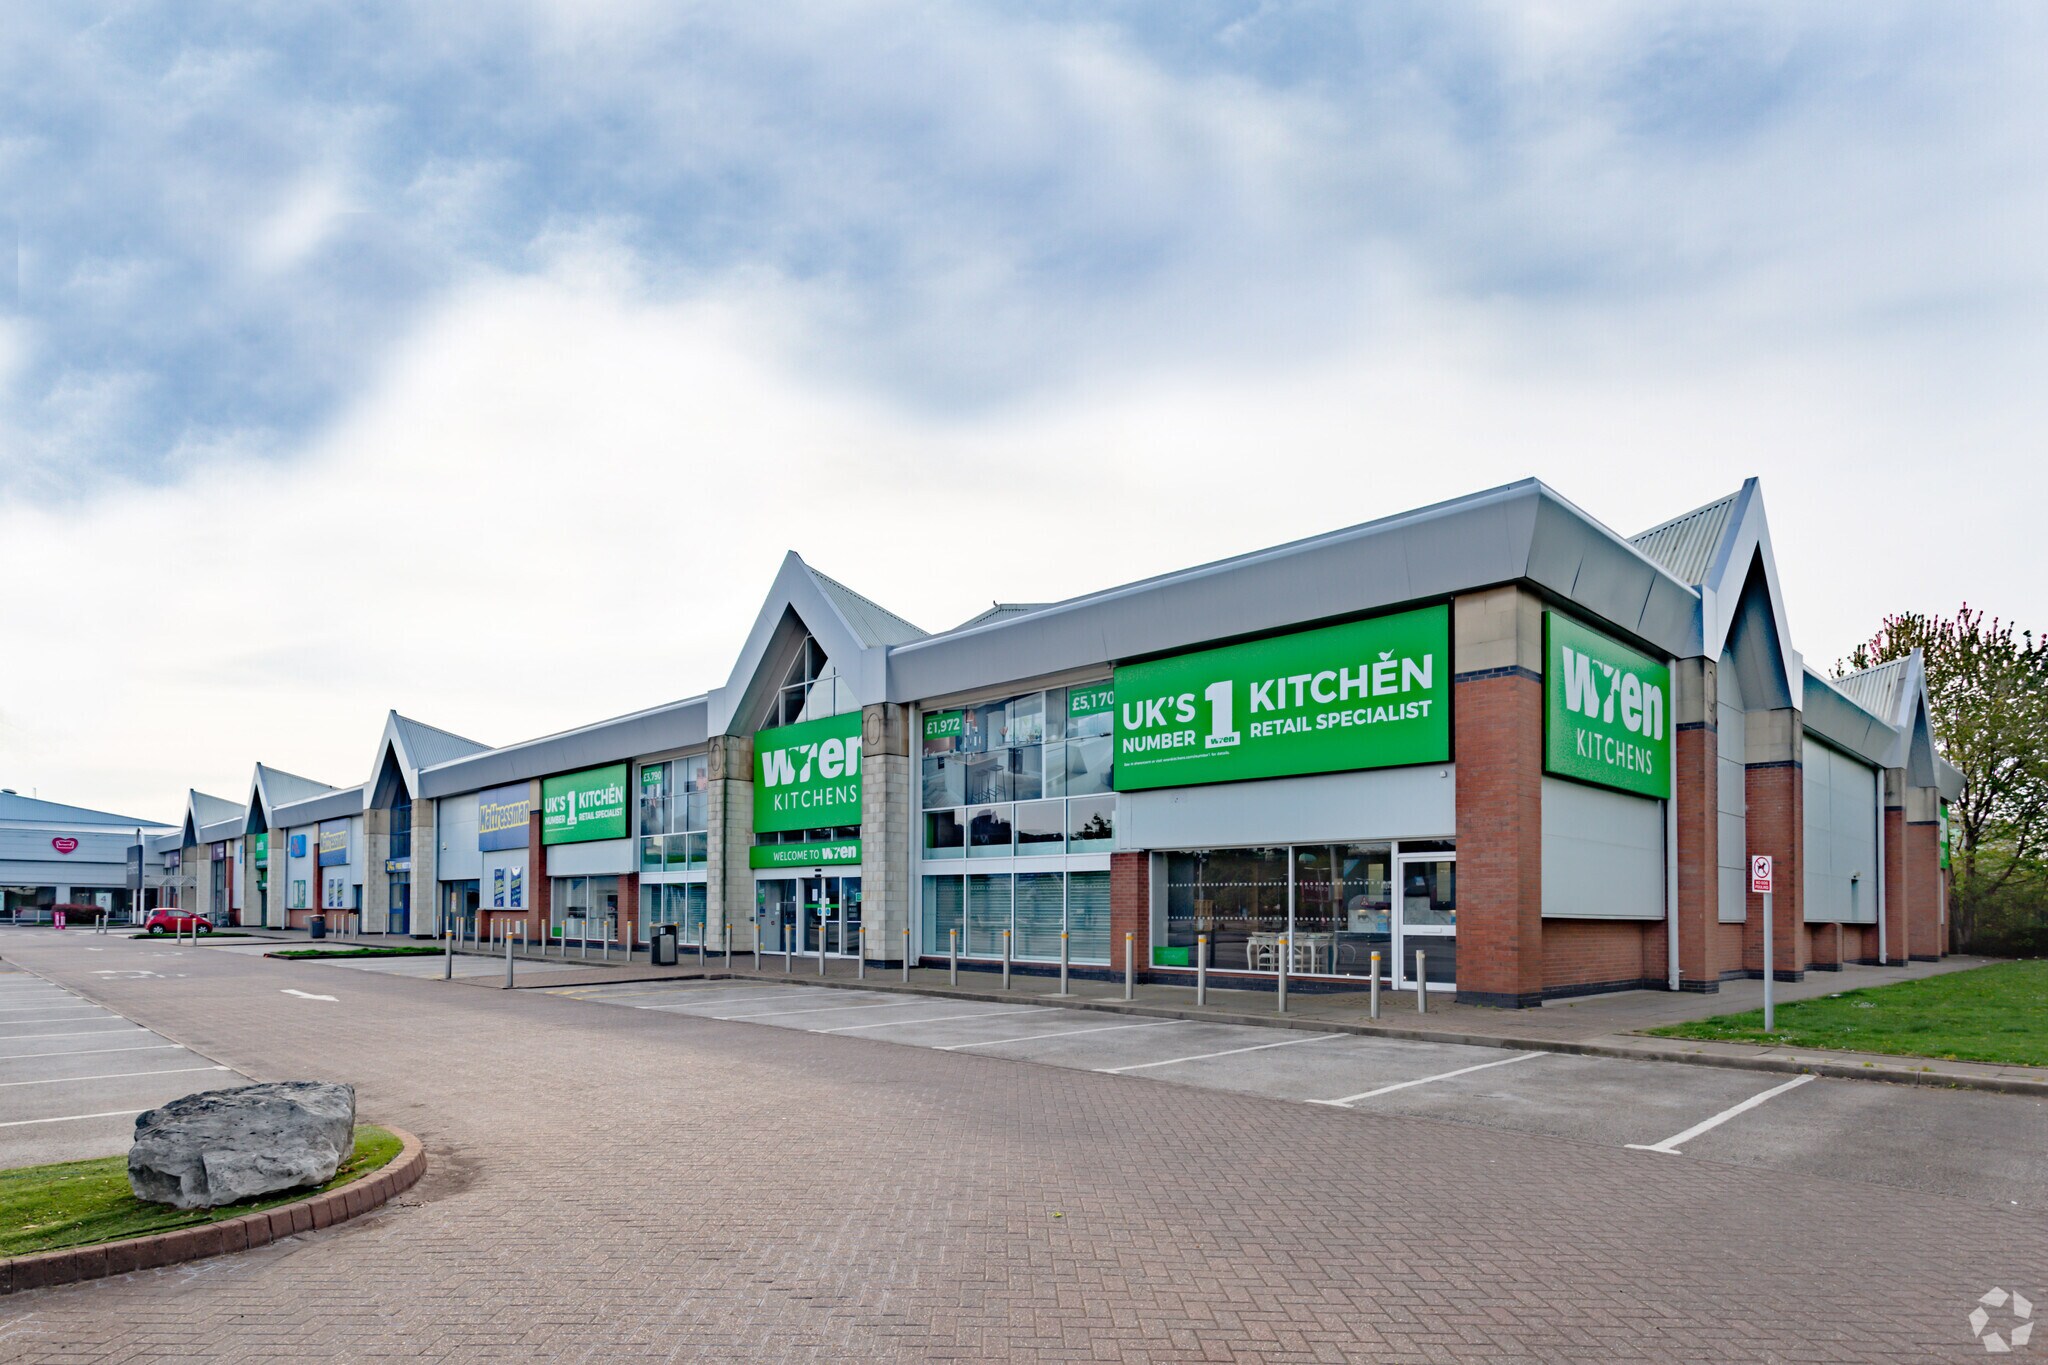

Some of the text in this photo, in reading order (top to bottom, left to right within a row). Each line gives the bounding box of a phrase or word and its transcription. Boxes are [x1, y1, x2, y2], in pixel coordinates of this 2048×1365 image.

[1250, 652, 1433, 713] KITCHEN
[1562, 645, 1663, 741] wren
[1072, 690, 1114, 711] £5,170
[1123, 693, 1196, 730] UK'S
[1205, 680, 1241, 749] 1
[1250, 700, 1433, 738] RETAIL SPECIALIST
[927, 718, 960, 735] £1,972
[1123, 730, 1196, 753] NUMBER
[1211, 735, 1235, 745] wren
[1576, 727, 1652, 774] KITCHENS
[643, 770, 662, 782] £3,790
[545, 796, 566, 813] UK'S
[567, 791, 577, 825] 1
[579, 785, 623, 808] KITCHEN
[774, 784, 857, 811] KITCHENS
[480, 800, 530, 833] Mattressman
[545, 814, 566, 825] NUMBER
[579, 811, 595, 821] RETAIL
[595, 807, 623, 819] SPECIALIST
[773, 845, 857, 861] WELCOME TO wren
